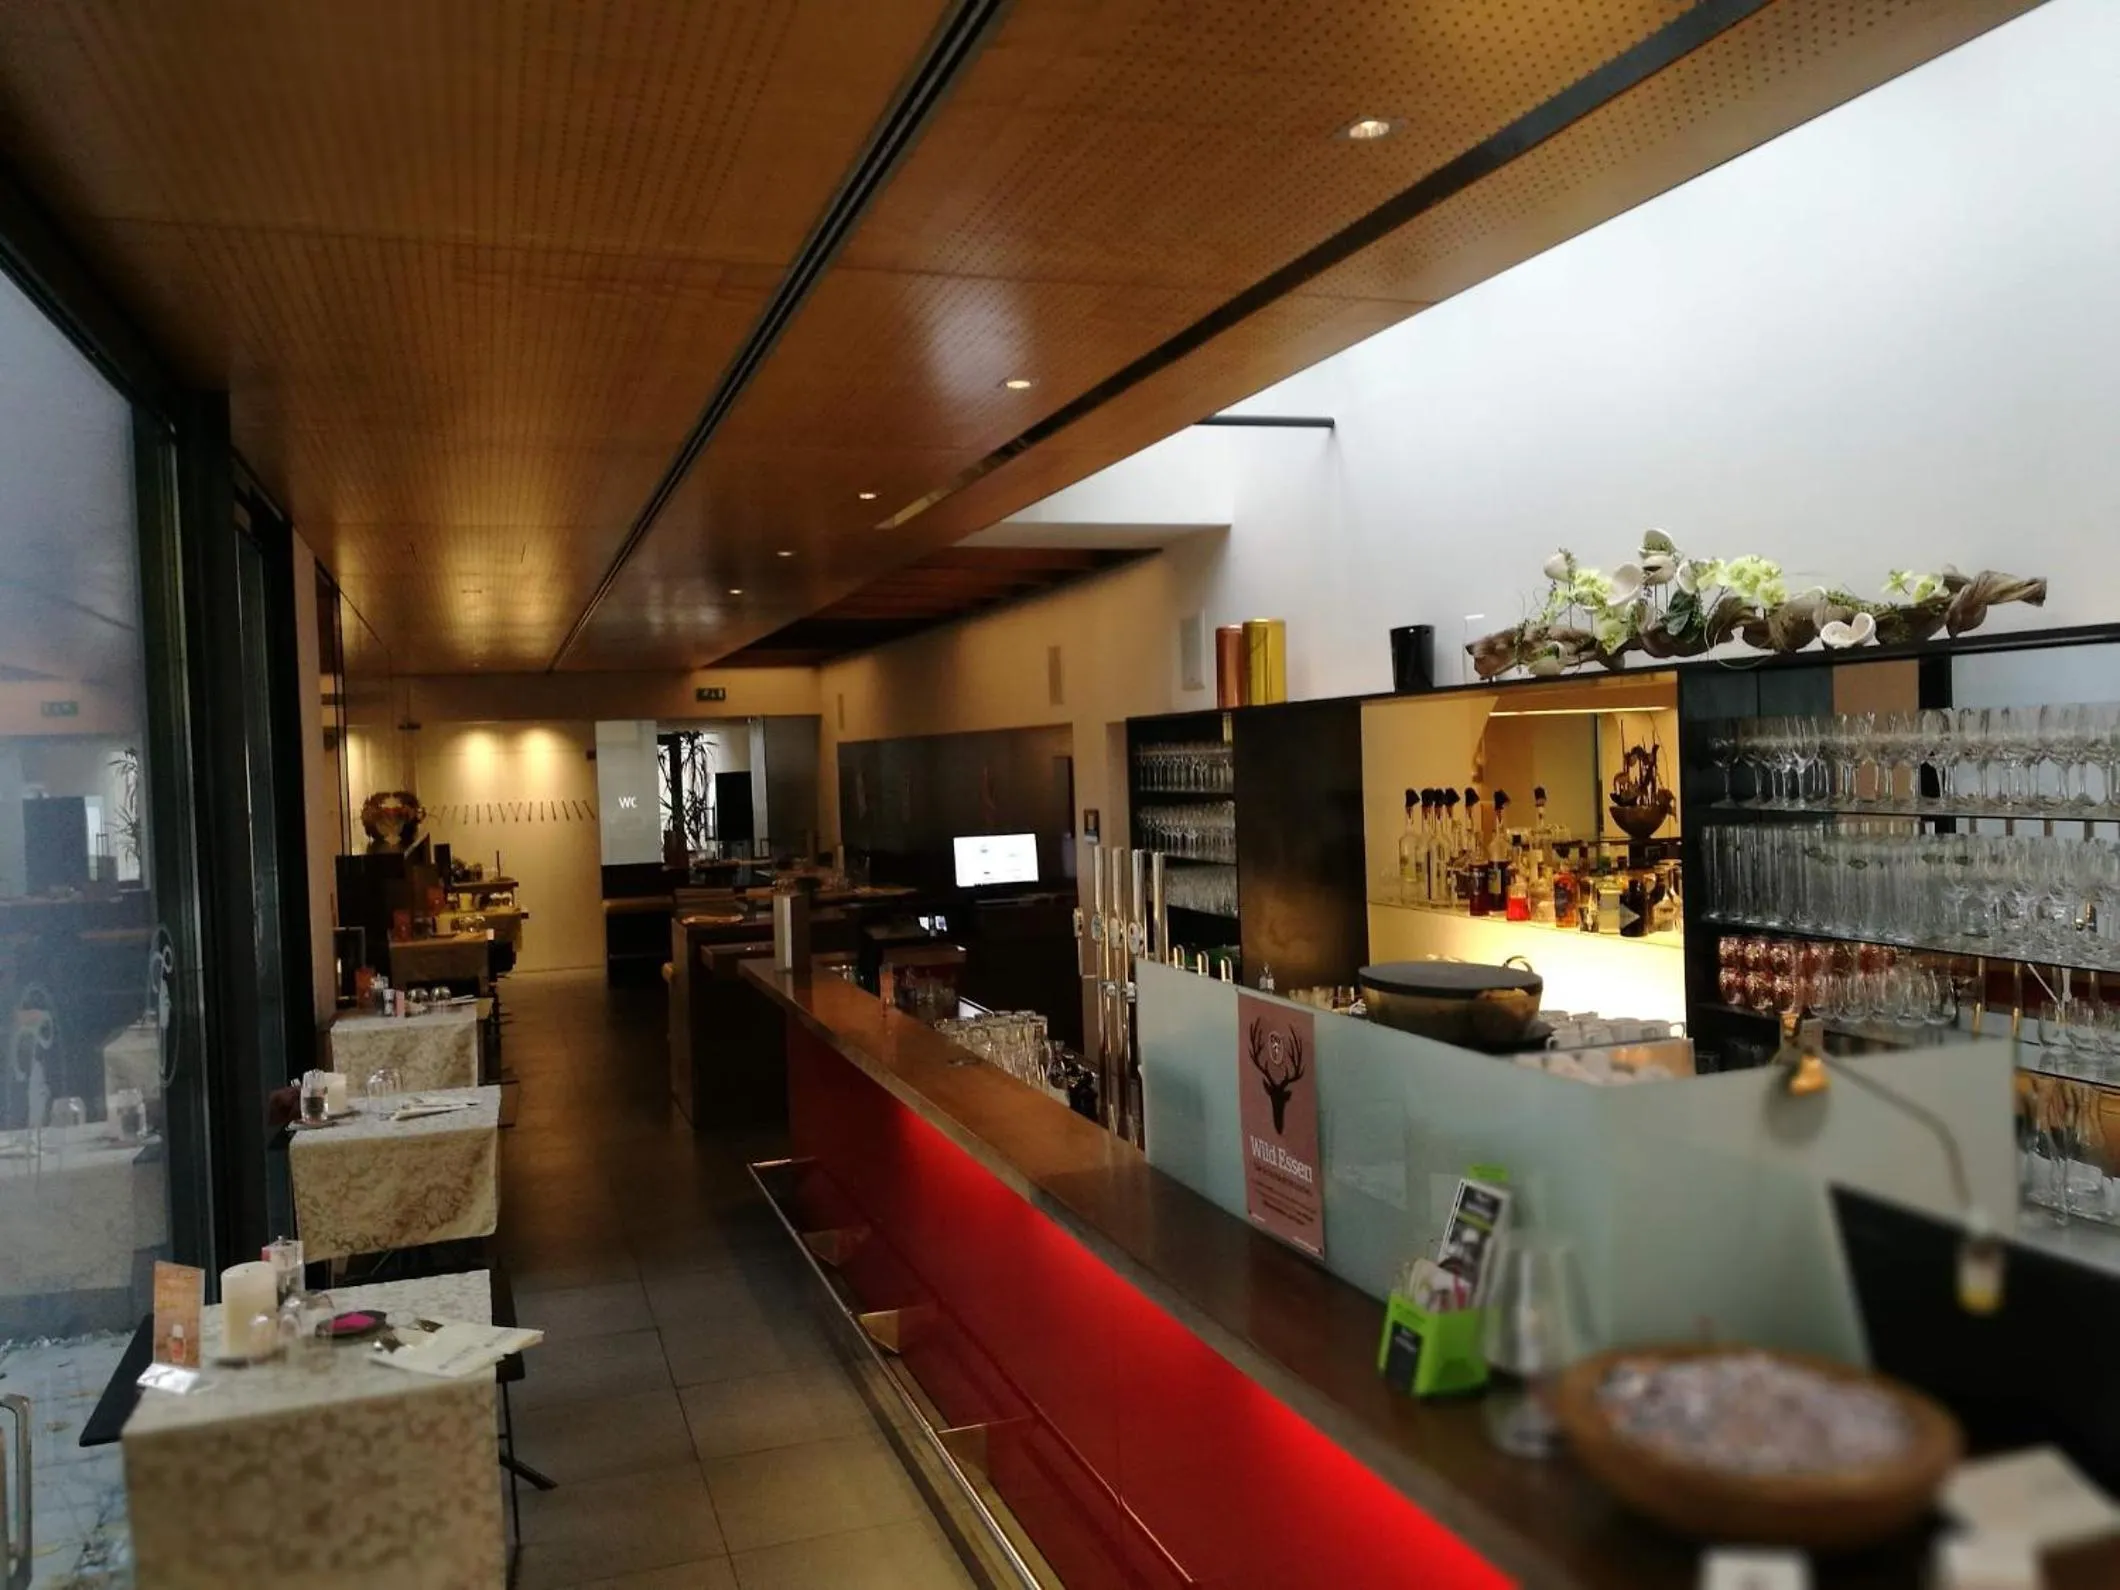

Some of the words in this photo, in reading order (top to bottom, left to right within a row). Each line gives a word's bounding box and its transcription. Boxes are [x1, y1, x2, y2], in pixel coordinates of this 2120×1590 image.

[618, 796, 638, 809] WC
[1249, 1135, 1277, 1166] Wild
[1278, 1147, 1313, 1184] Essen
